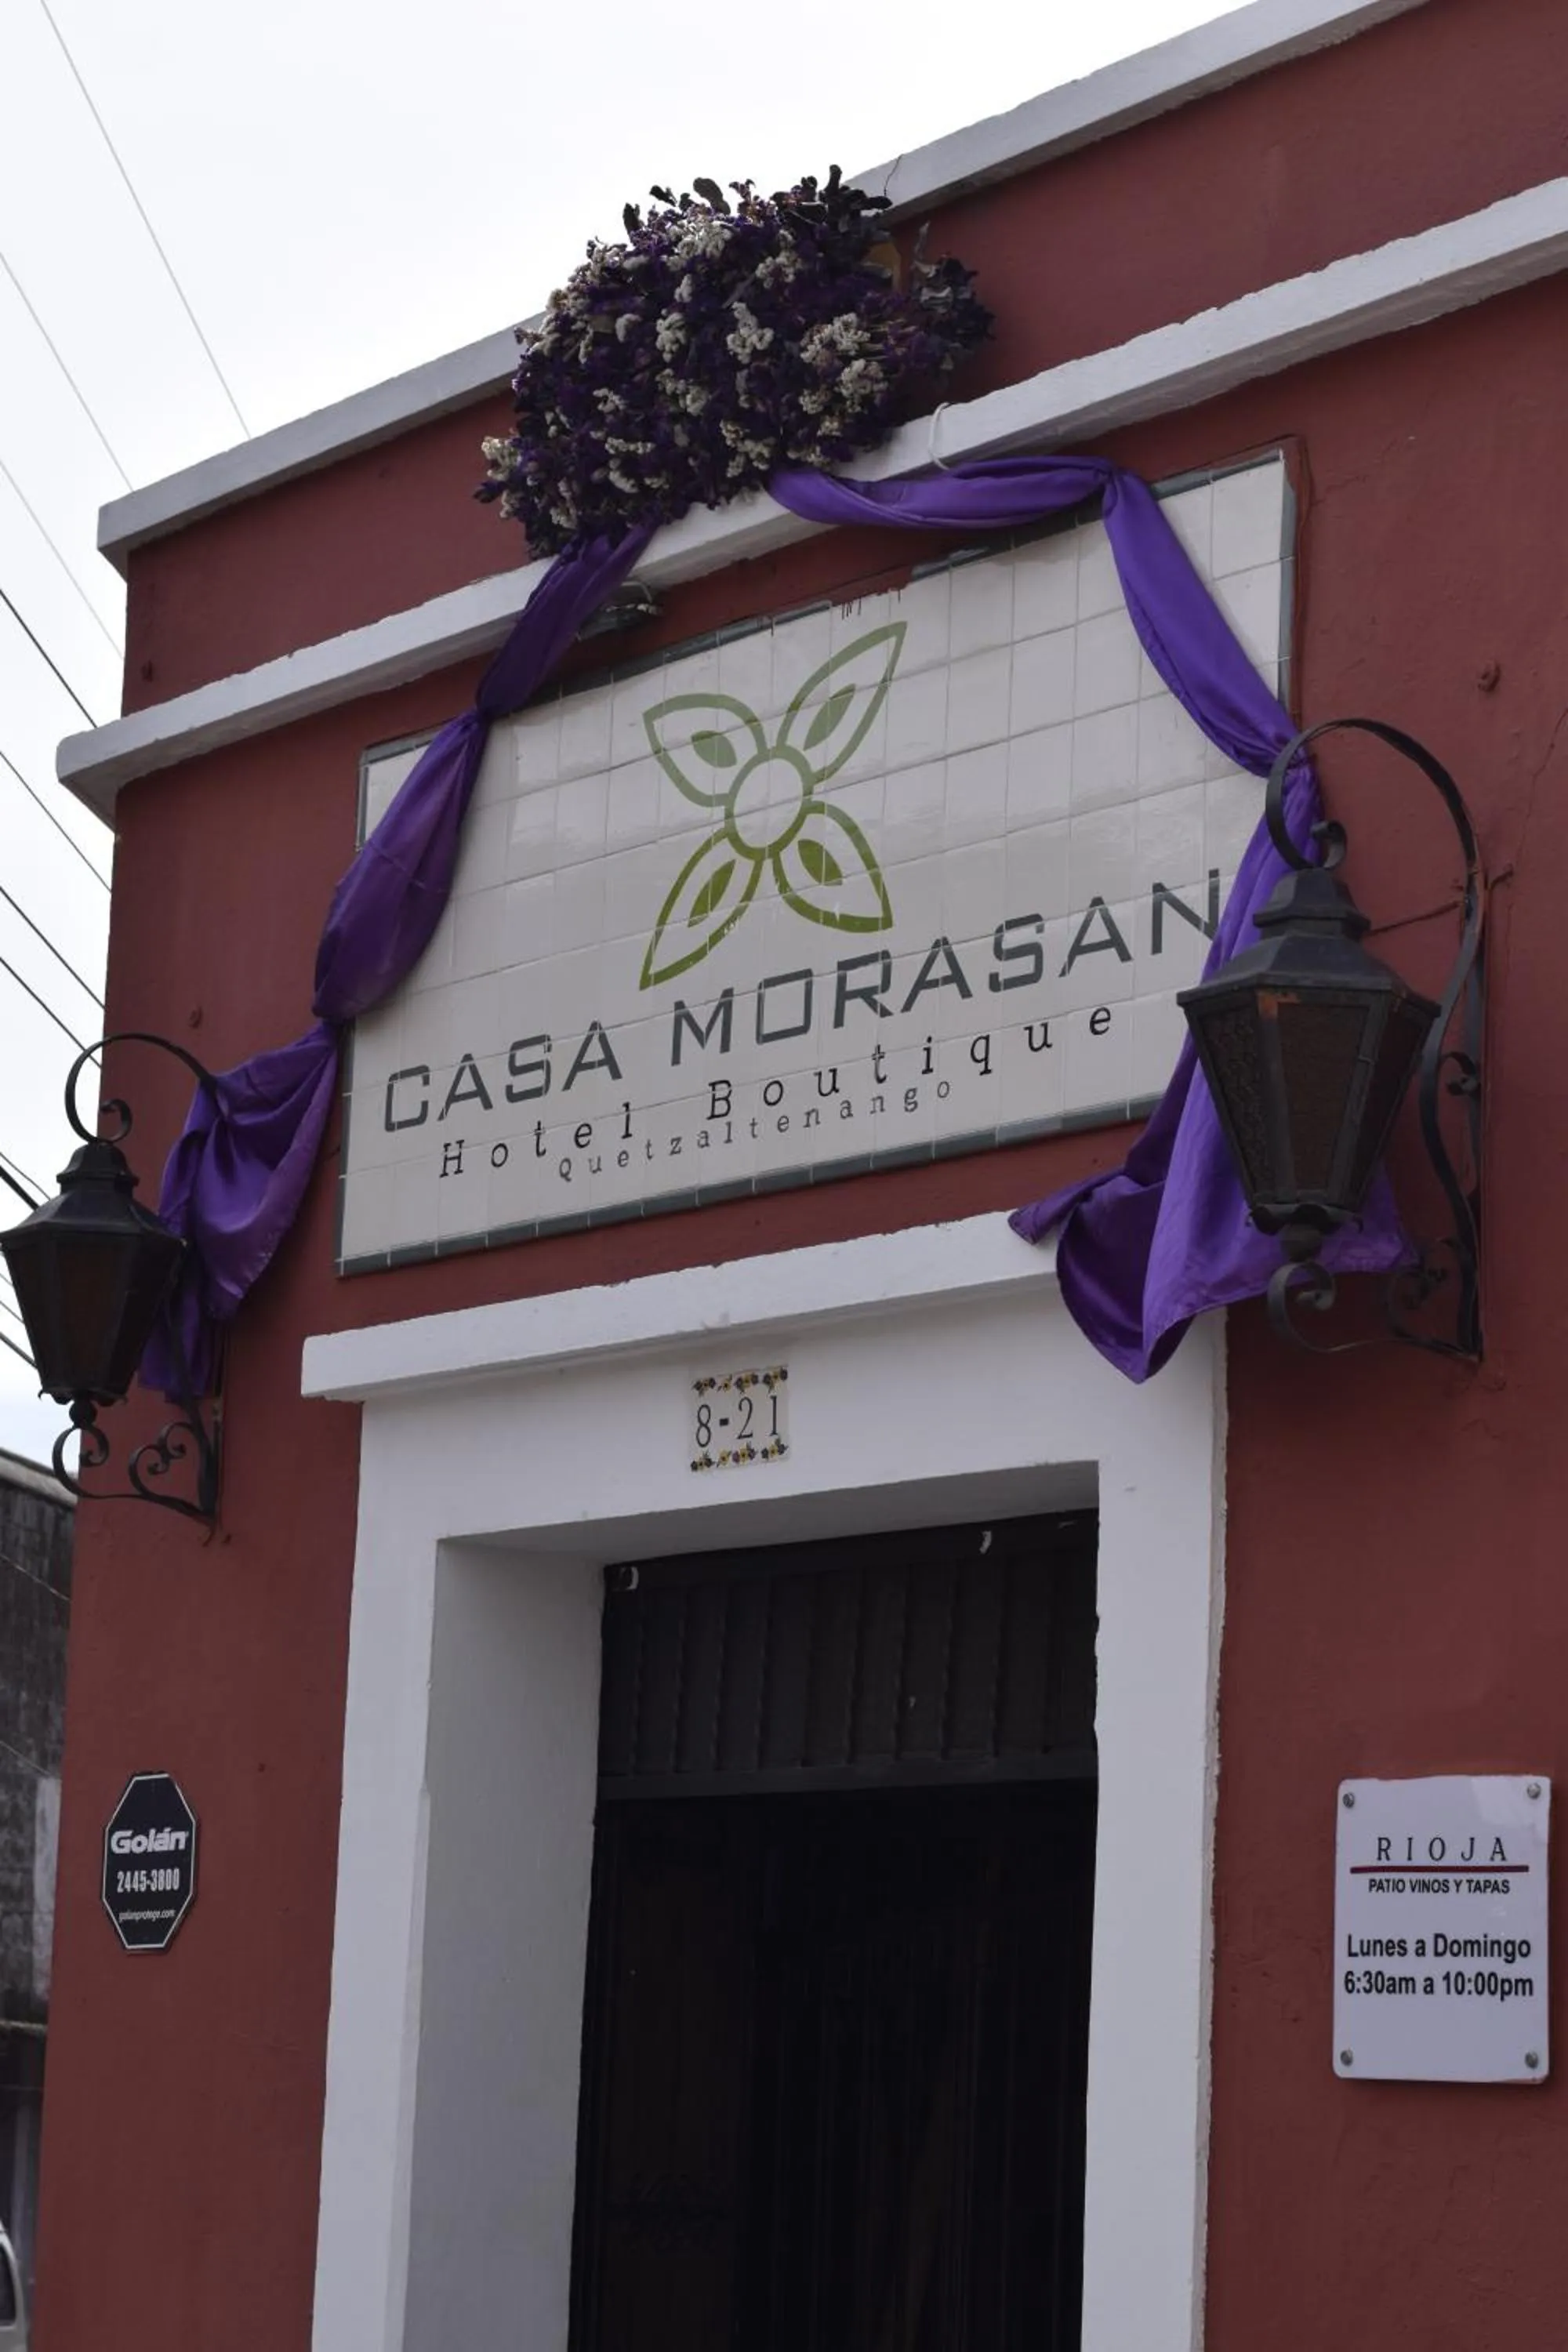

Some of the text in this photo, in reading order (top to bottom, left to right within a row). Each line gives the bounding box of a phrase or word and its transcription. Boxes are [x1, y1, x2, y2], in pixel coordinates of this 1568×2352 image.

[384, 869, 1219, 1131] CASA MORASAN
[440, 1005, 1112, 1178] Hotel Boutique
[696, 1396, 778, 1448] 8-21
[111, 1828, 187, 1854] Golán
[1368, 1878, 1511, 1894] PATIO VINOS Y TAPAS
[1347, 1933, 1531, 1964] Lunes a Domingo
[1344, 1971, 1534, 2002] 6:30am a 10:00pm
